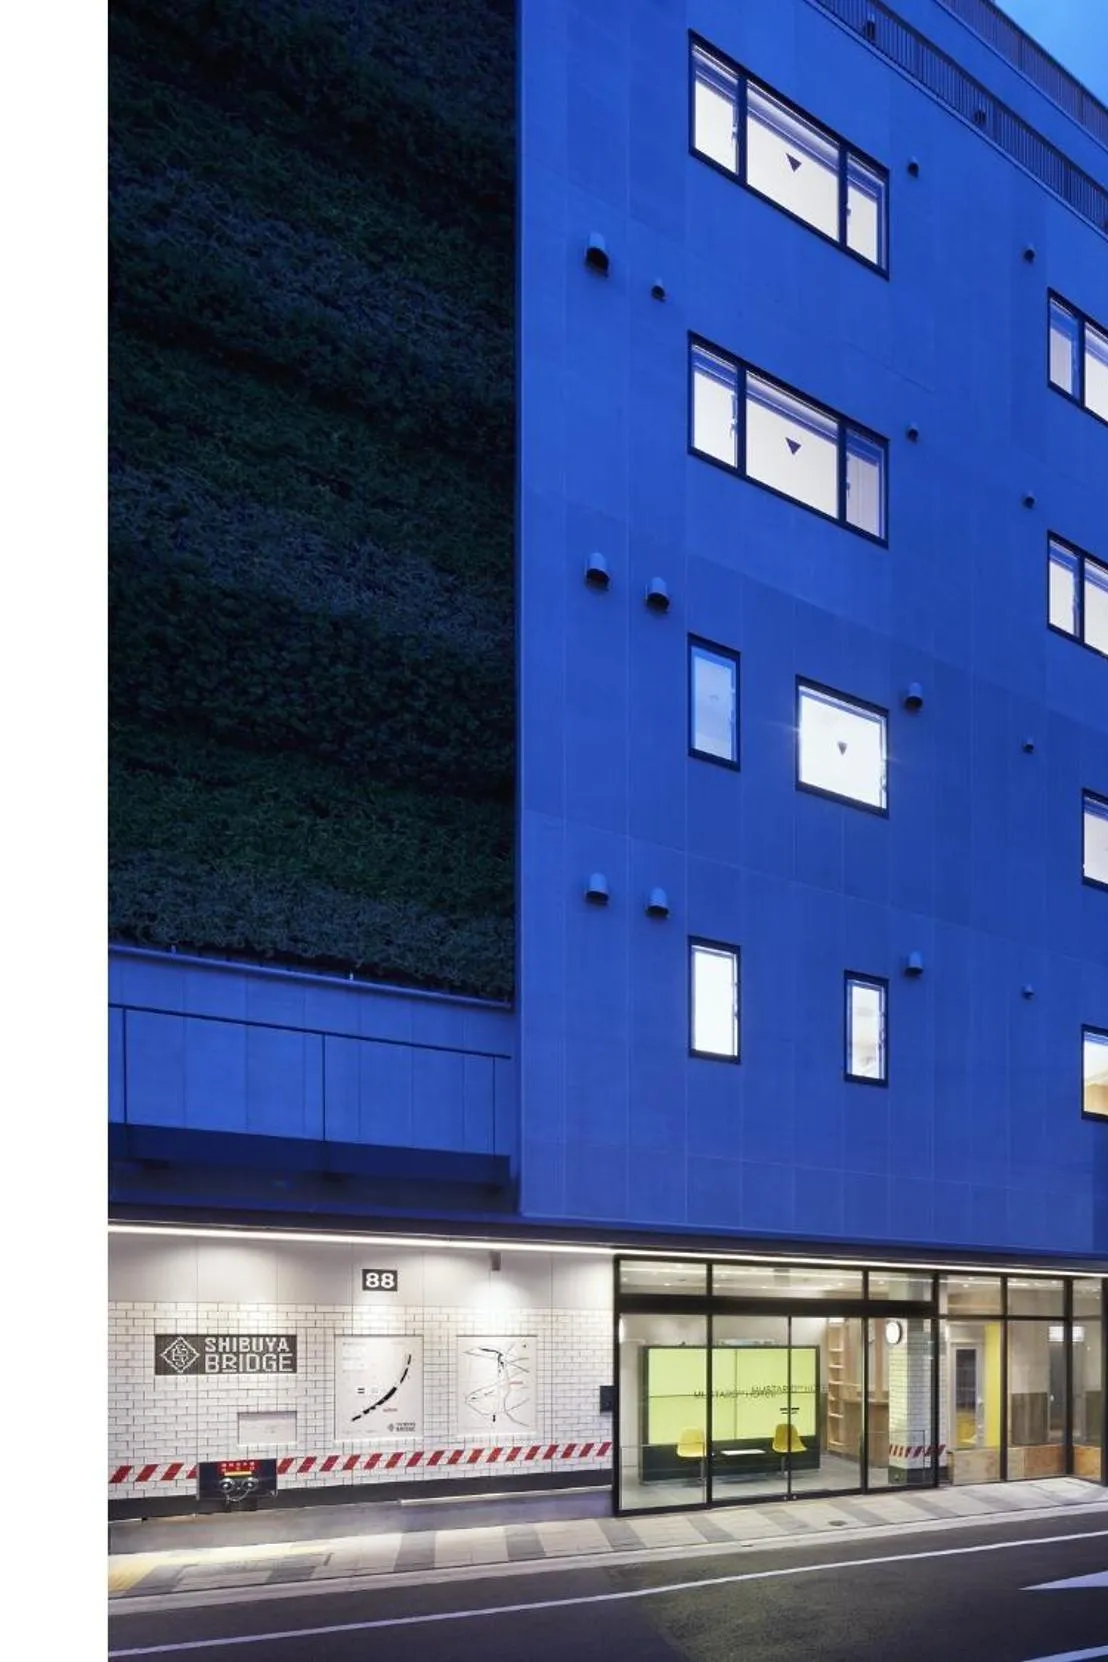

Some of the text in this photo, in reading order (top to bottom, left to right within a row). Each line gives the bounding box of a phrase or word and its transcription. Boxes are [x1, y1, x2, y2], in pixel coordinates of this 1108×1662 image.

[365, 1272, 395, 1288] 88
[204, 1336, 290, 1352] SHIBUYA
[204, 1353, 293, 1373] BRIDGE
